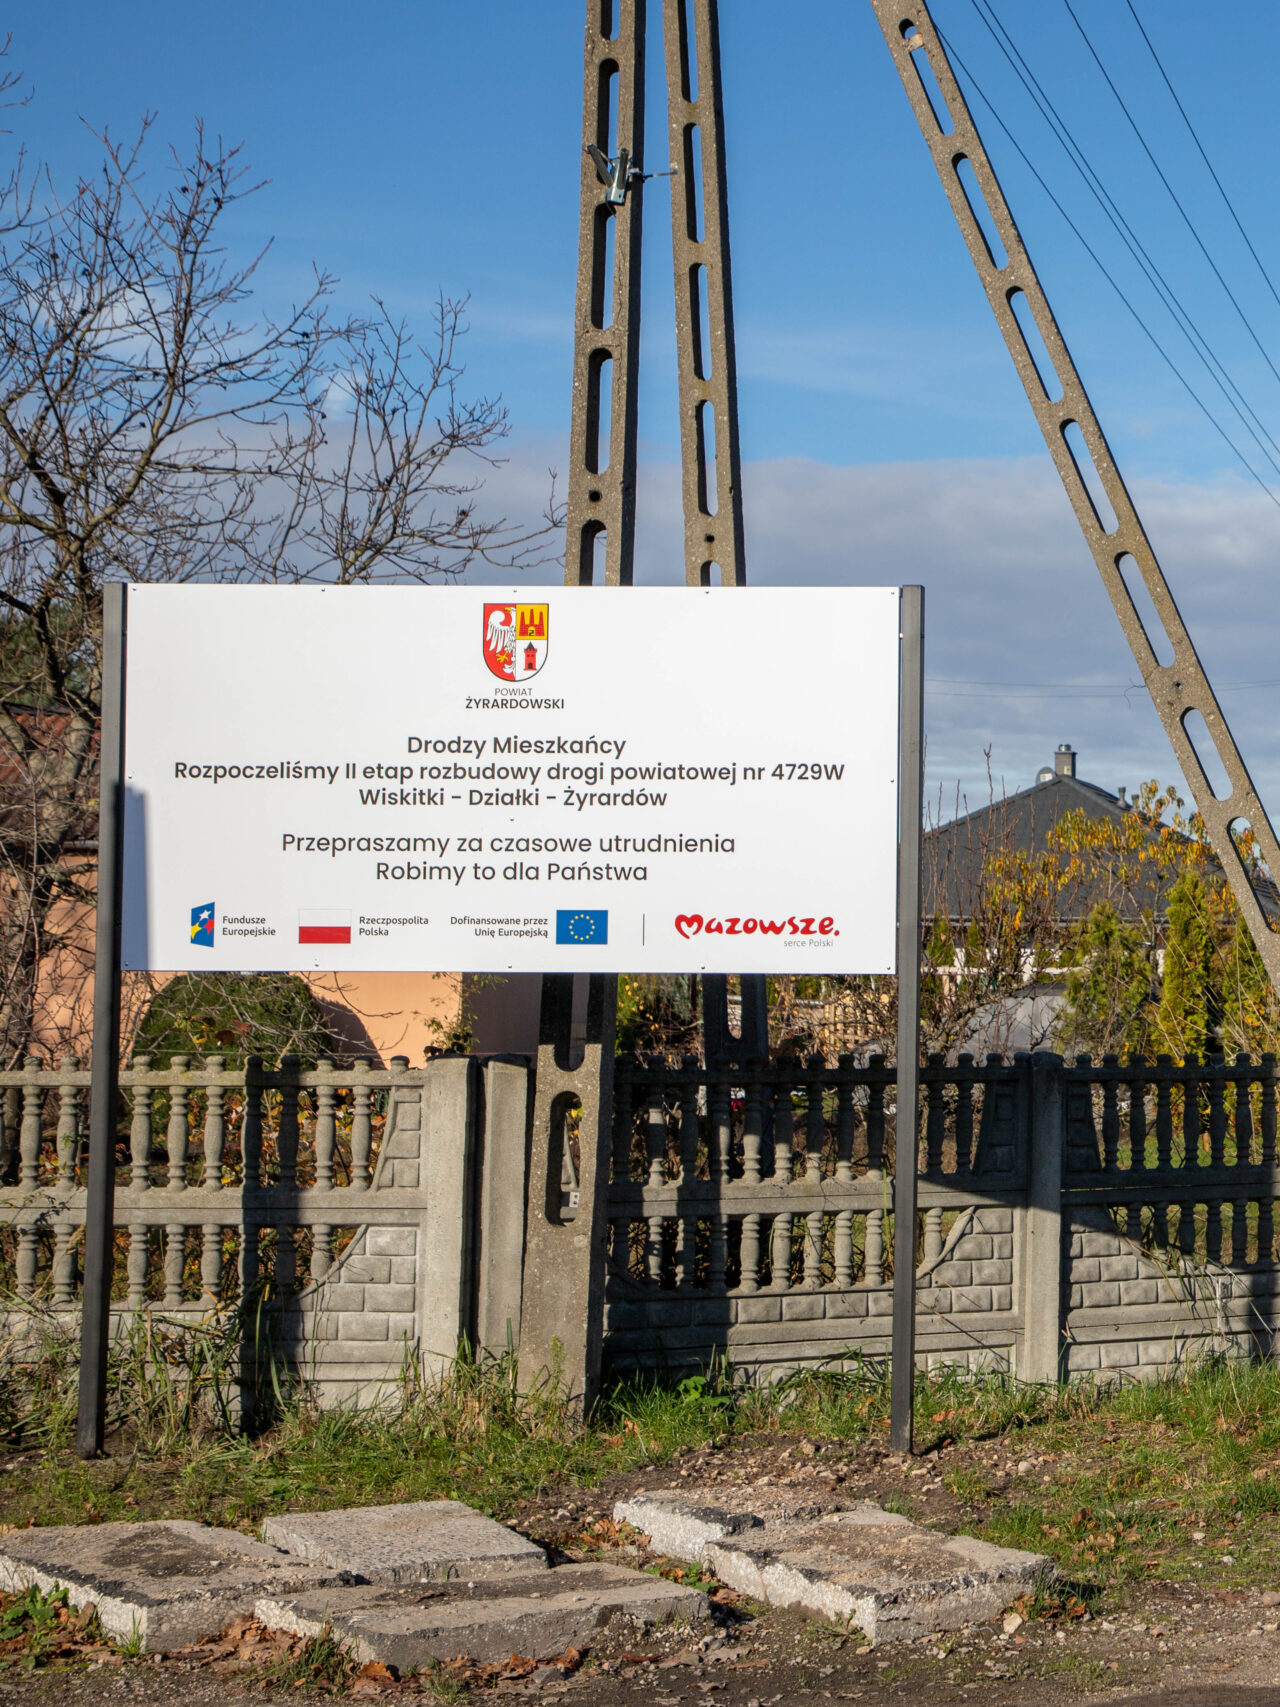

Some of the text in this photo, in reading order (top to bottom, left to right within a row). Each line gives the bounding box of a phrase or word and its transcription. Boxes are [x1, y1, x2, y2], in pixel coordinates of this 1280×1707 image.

[494, 687, 533, 697] POWIAT
[465, 695, 565, 710] ŻYRARDOWSKI
[407, 735, 627, 759] Drodzy Mieszkańcy
[174, 760, 845, 785] Rozpoczeliśmy II etap rozbudowy drogi powiatowej nr 4729W
[358, 787, 445, 806] Wiskitki
[468, 787, 540, 806] Działki
[563, 785, 668, 811] Żyrardów
[282, 833, 735, 858] Przepraszamy za czasowe utrudnienia
[376, 861, 648, 886] Robimy to dla Państwa
[222, 915, 267, 925] Fundusze
[359, 915, 429, 927] Rzeczpospolita
[450, 915, 548, 928] Dofinansowane przez
[222, 926, 277, 938] Europejskie
[359, 926, 389, 937] Polska
[474, 926, 549, 939] Unię Europejską
[808, 938, 834, 948] Polski
